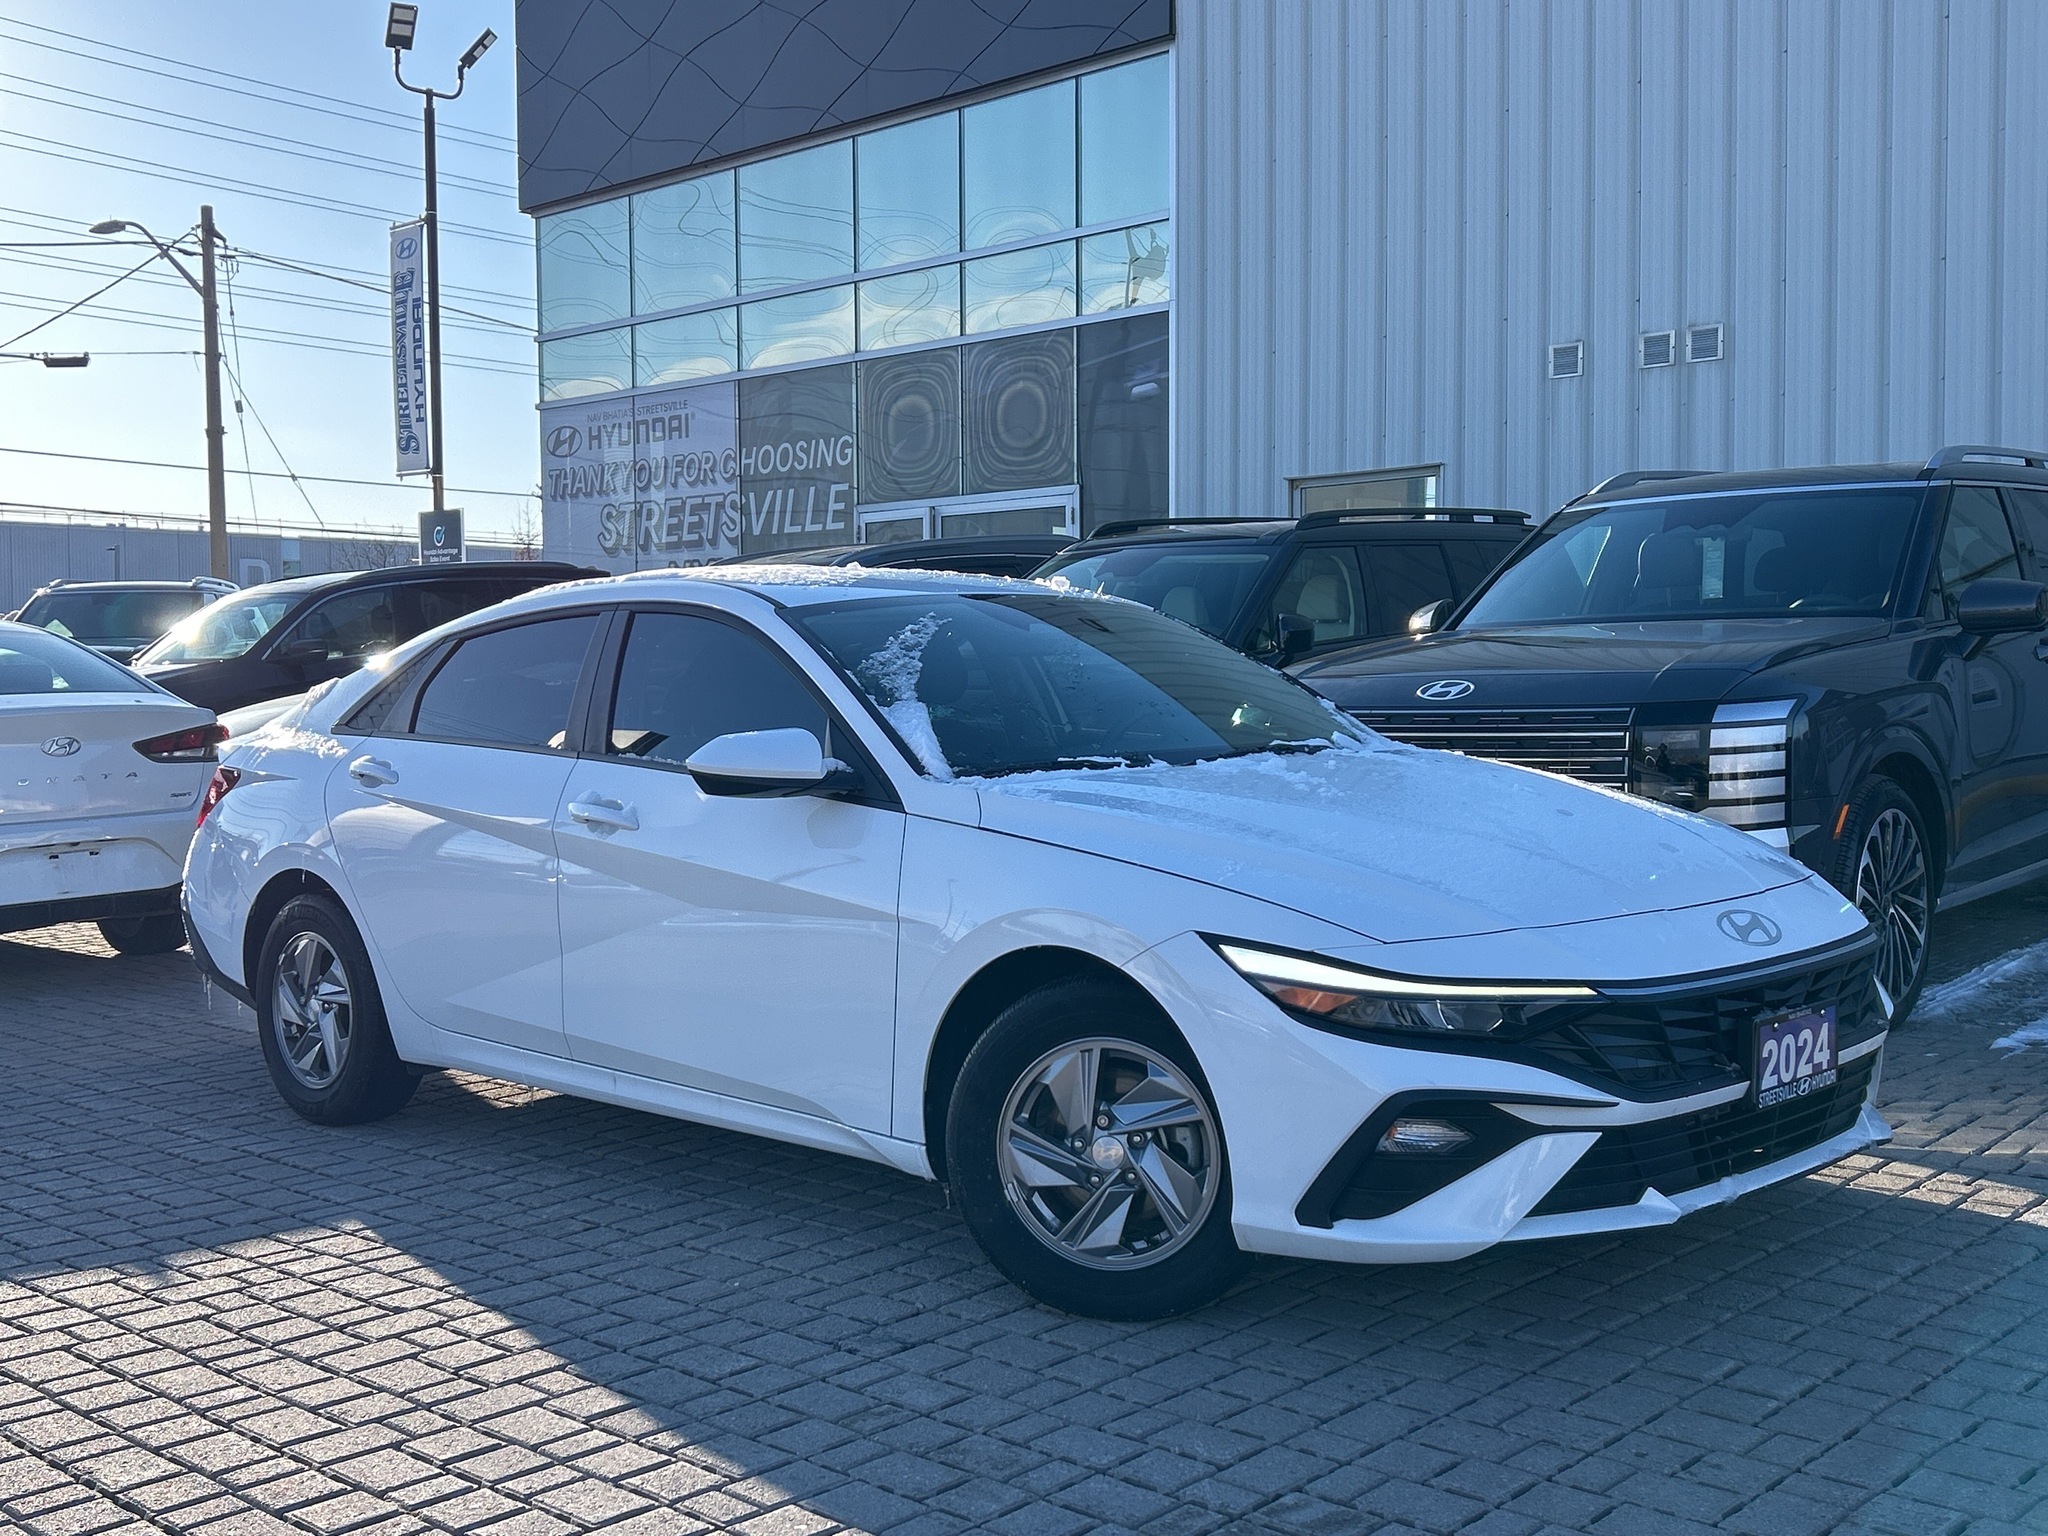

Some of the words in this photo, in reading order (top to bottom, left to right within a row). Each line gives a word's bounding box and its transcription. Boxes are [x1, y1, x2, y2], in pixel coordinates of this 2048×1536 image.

[412, 296, 425, 423] HYUNDAI
[588, 412, 690, 451] HYUNDAI
[602, 408, 634, 421] BHATIA'S
[636, 399, 688, 416] STREETSVILLE
[549, 461, 620, 500] THANK
[616, 455, 666, 494] YOU
[669, 449, 720, 489] FOR
[718, 434, 853, 481] CHOOSING
[597, 482, 850, 558] STREETSVILLE
[1762, 1022, 1831, 1091] 2024
[1758, 1082, 1797, 1109] STREETSVILLE
